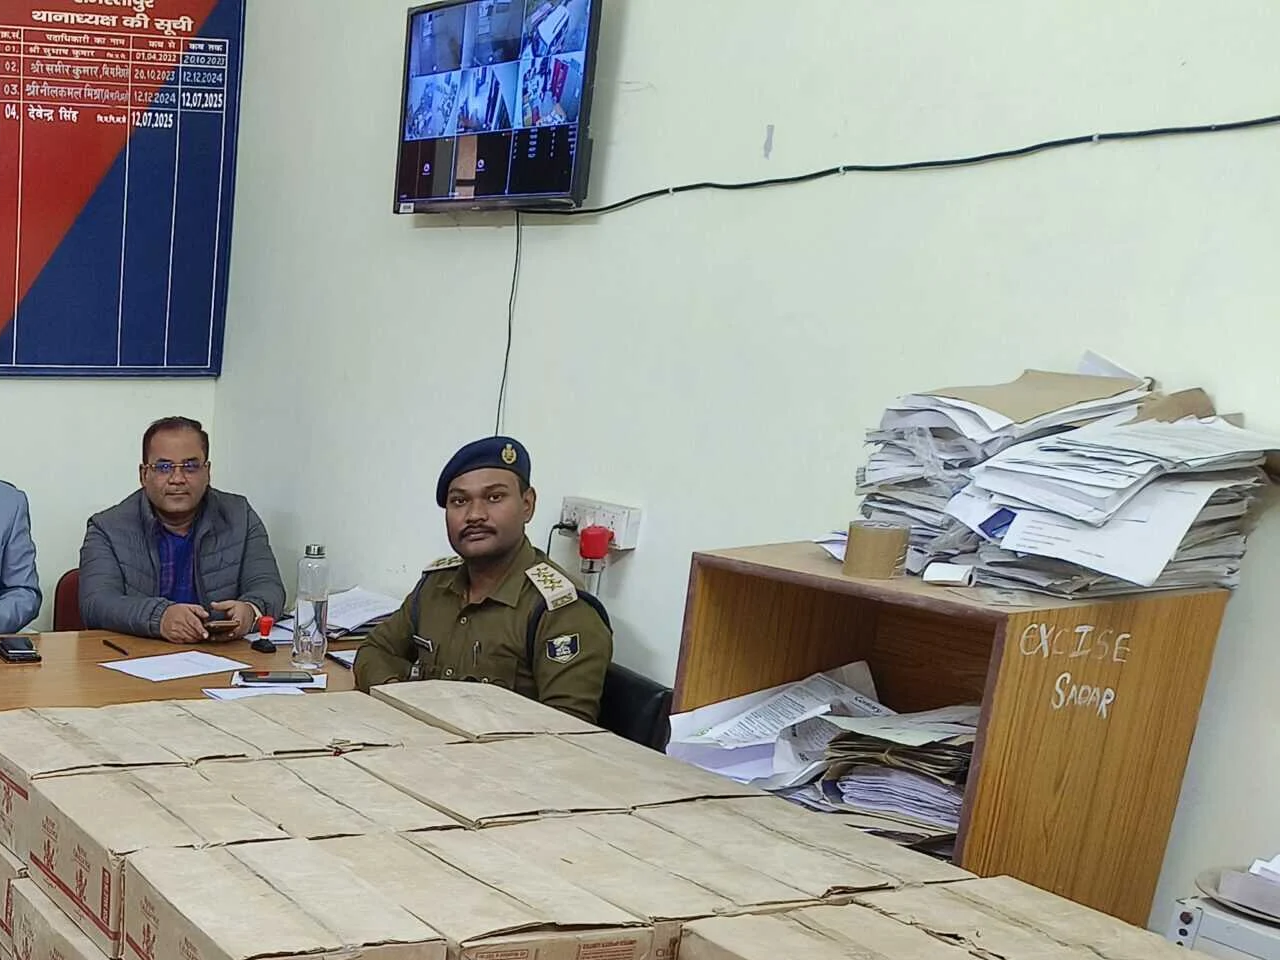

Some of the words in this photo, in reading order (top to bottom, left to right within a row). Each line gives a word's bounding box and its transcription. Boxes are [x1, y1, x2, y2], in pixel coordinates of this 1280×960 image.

[122, 14, 150, 29] की
[154, 16, 194, 36] सूची
[31, 60, 44, 73] श्री
[134, 68, 175, 80] 20.10.2023
[183, 71, 223, 83] 12.12.2024
[25, 81, 39, 97] श्री
[133, 91, 176, 104] 12.12.2024
[27, 105, 54, 122] देवेन्द्र
[59, 107, 79, 122] सिंह
[1020, 623, 1131, 663] EXCISE
